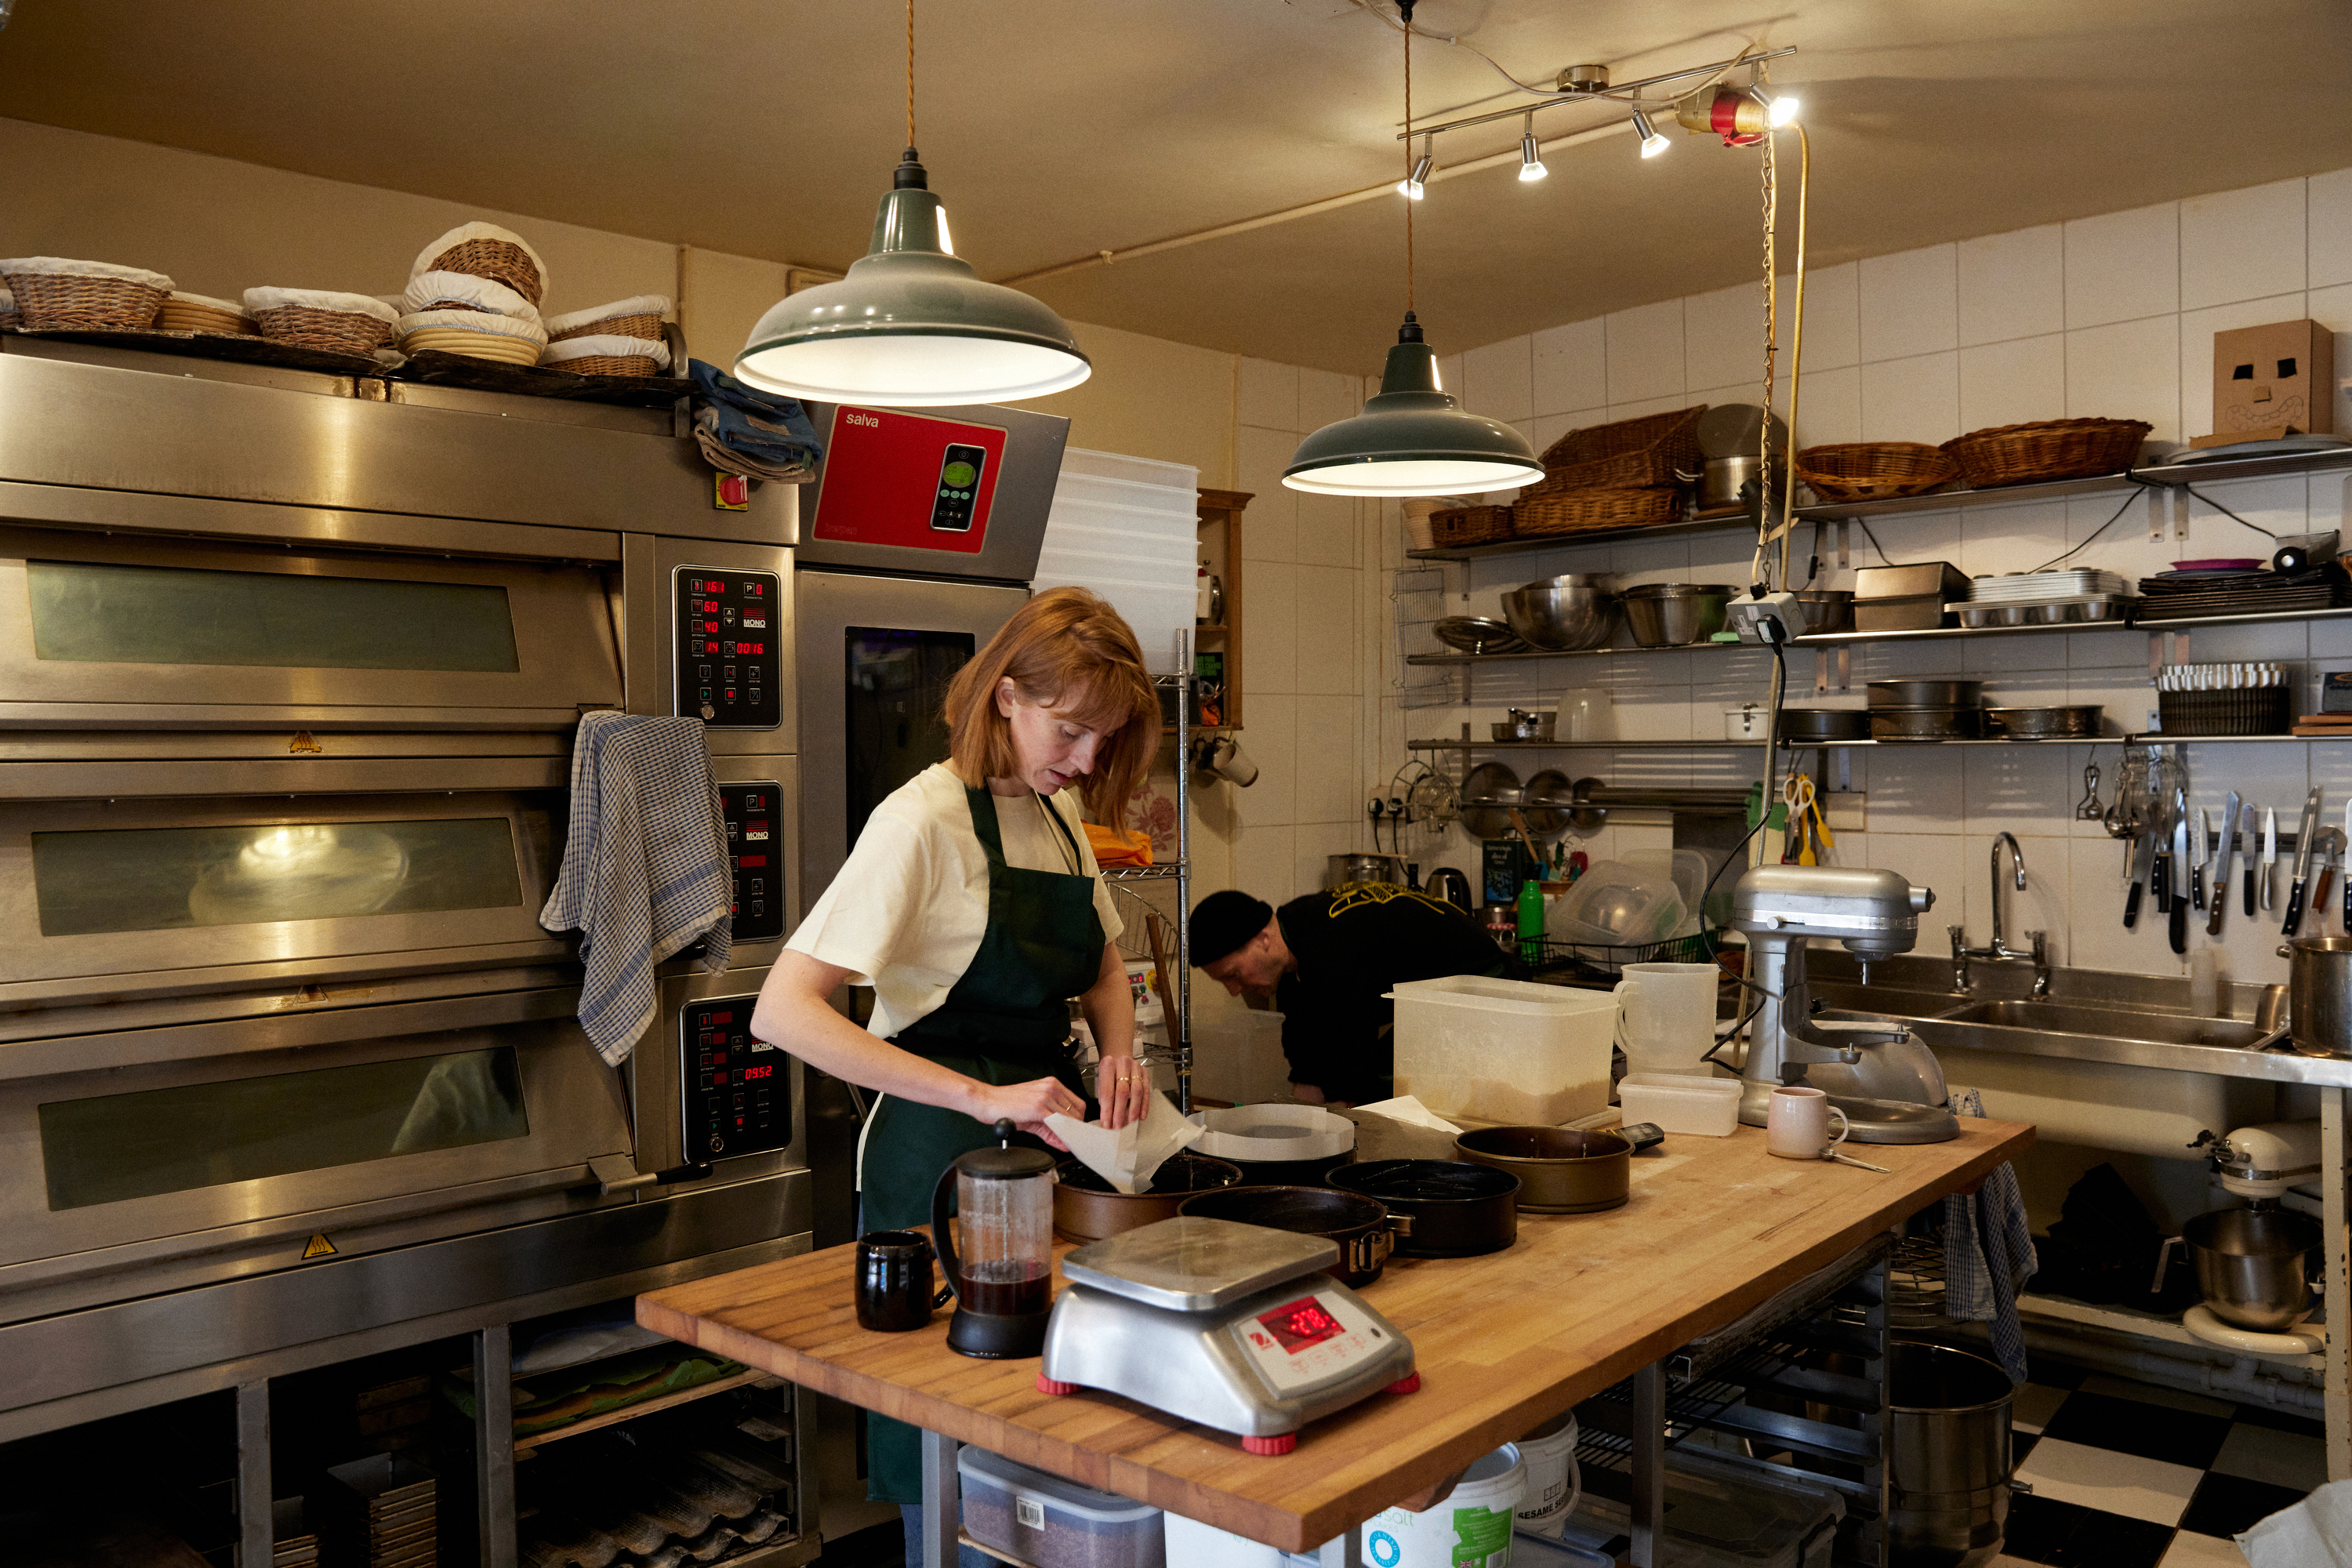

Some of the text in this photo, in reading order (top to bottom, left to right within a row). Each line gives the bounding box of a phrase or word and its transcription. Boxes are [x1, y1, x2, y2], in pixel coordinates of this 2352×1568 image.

[846, 413, 879, 428] salva
[706, 581, 724, 593] 161
[704, 601, 718, 612] 60
[705, 622, 718, 633] 40
[743, 619, 766, 627] MONO
[708, 642, 719, 652] 14
[752, 1043, 774, 1051] MONO
[1518, 1503, 1554, 1519] SESAME
[1370, 1532, 1399, 1550] CORNISH
